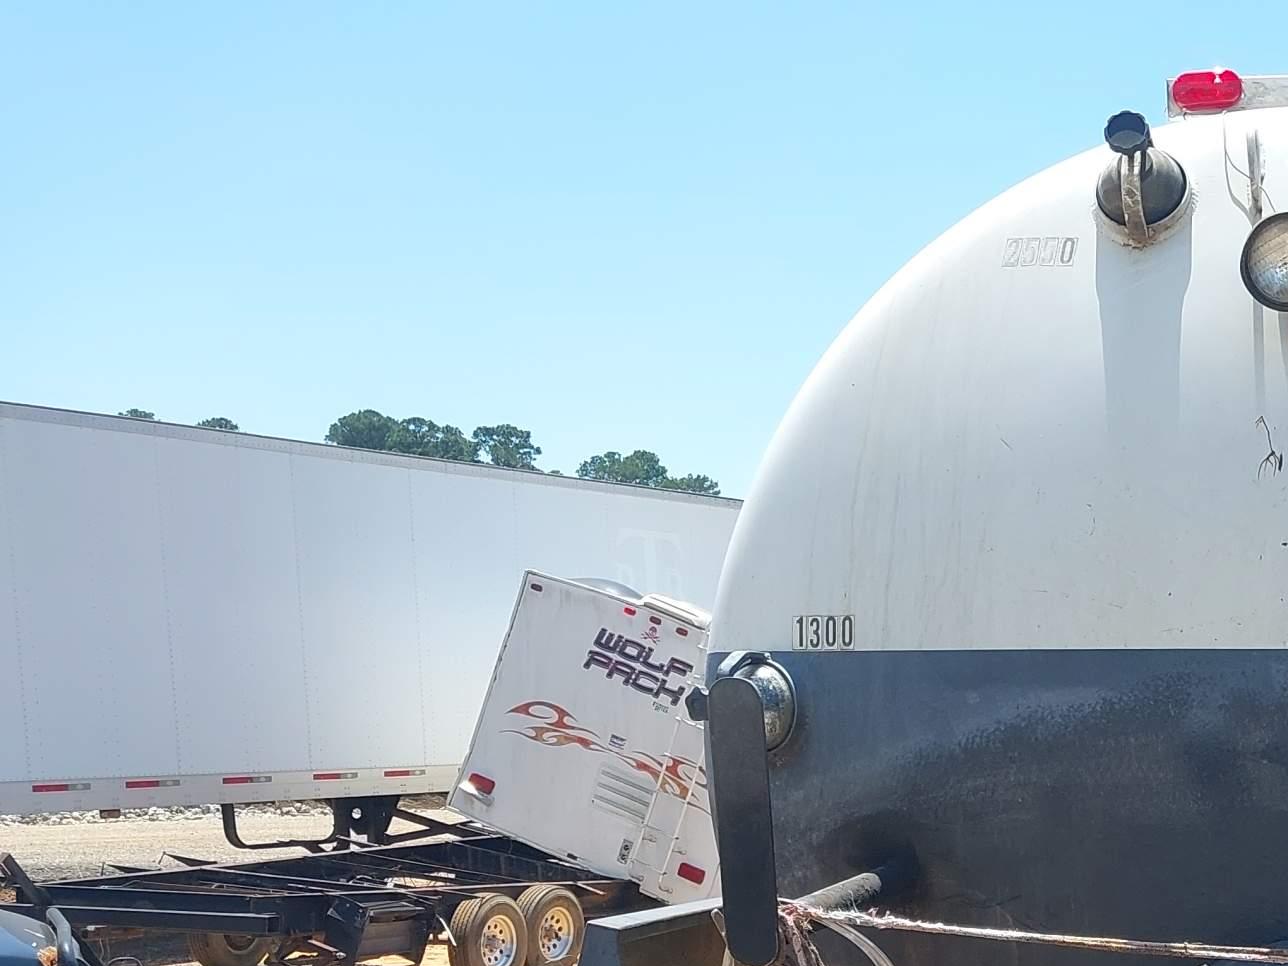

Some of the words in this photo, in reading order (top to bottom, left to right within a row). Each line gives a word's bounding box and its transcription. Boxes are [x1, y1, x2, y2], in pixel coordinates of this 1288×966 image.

[593, 627, 694, 677] WOLF
[796, 615, 853, 648] 1300
[583, 649, 686, 707] PACK
